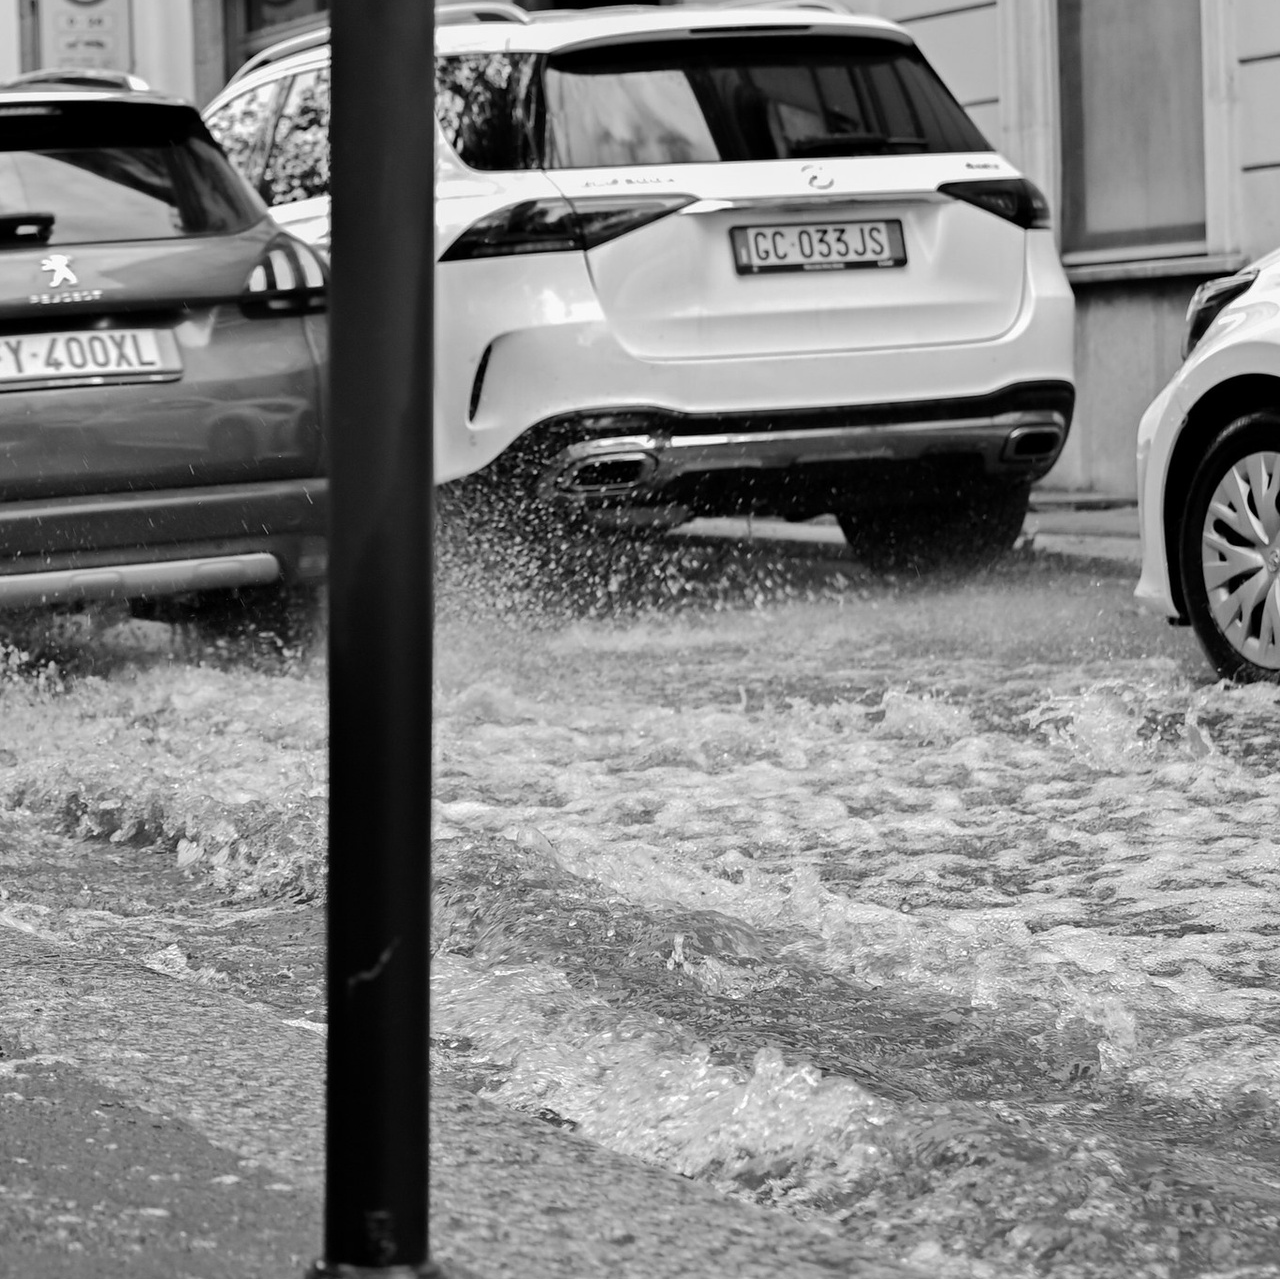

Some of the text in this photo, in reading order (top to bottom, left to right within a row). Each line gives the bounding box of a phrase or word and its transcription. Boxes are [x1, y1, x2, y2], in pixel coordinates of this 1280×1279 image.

[753, 226, 885, 261] GC 033JS
[44, 333, 157, 372] 400XL
